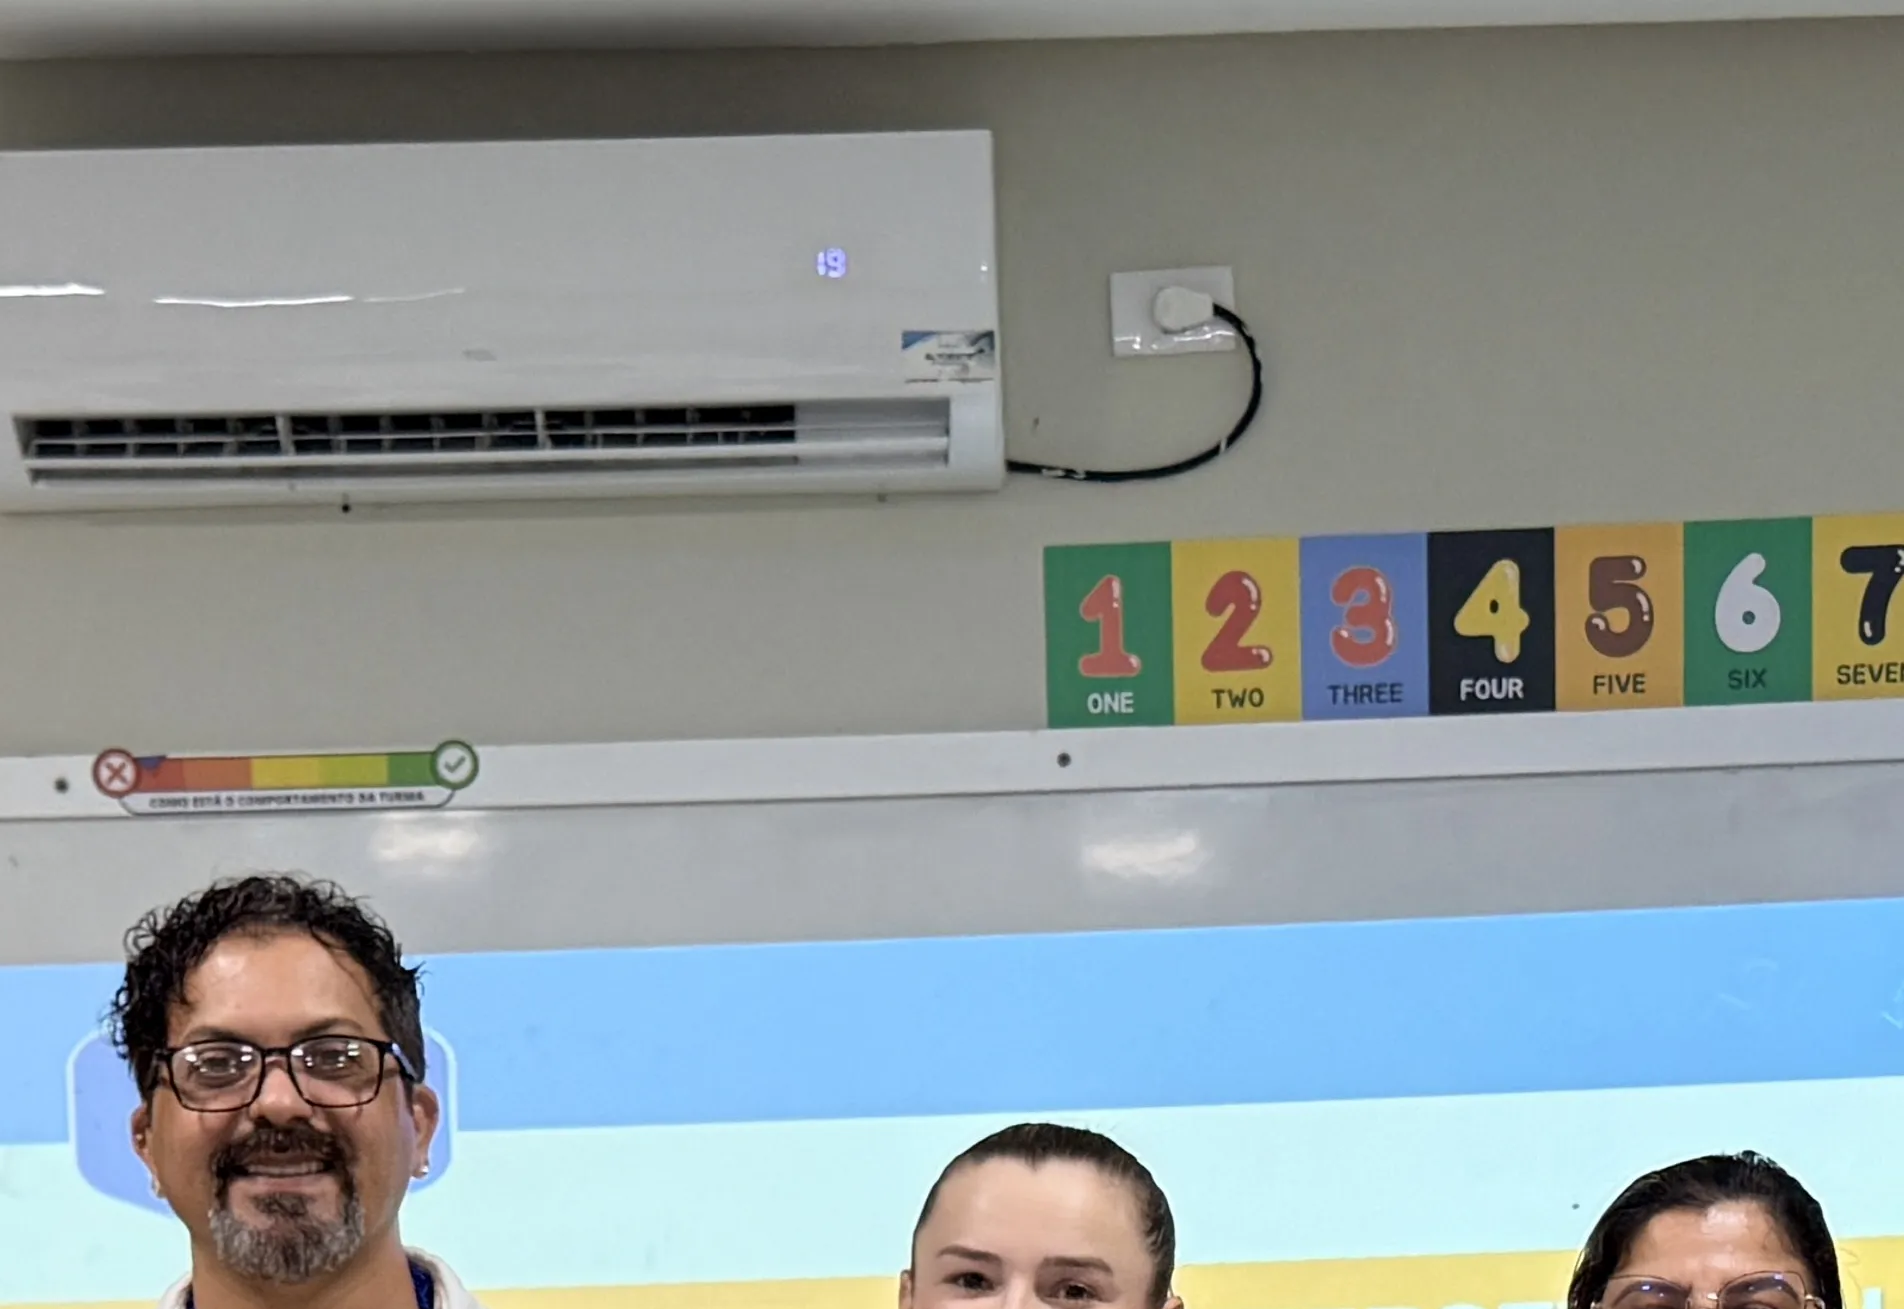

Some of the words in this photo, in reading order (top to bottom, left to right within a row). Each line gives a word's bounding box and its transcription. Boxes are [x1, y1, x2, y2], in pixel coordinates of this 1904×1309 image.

[817, 247, 846, 278] 19
[1078, 574, 1141, 677] 1
[1201, 571, 1273, 672] 2
[1331, 565, 1396, 668] 3
[1453, 558, 1530, 663] 4
[1585, 555, 1654, 658] 5
[1715, 552, 1781, 652] 6
[1087, 692, 1134, 713] ONE
[1212, 688, 1264, 709] TWO
[1328, 683, 1403, 705] THREE
[1460, 677, 1524, 700] FOUR
[1593, 673, 1646, 694] FIVE
[1728, 668, 1767, 690] SIX
